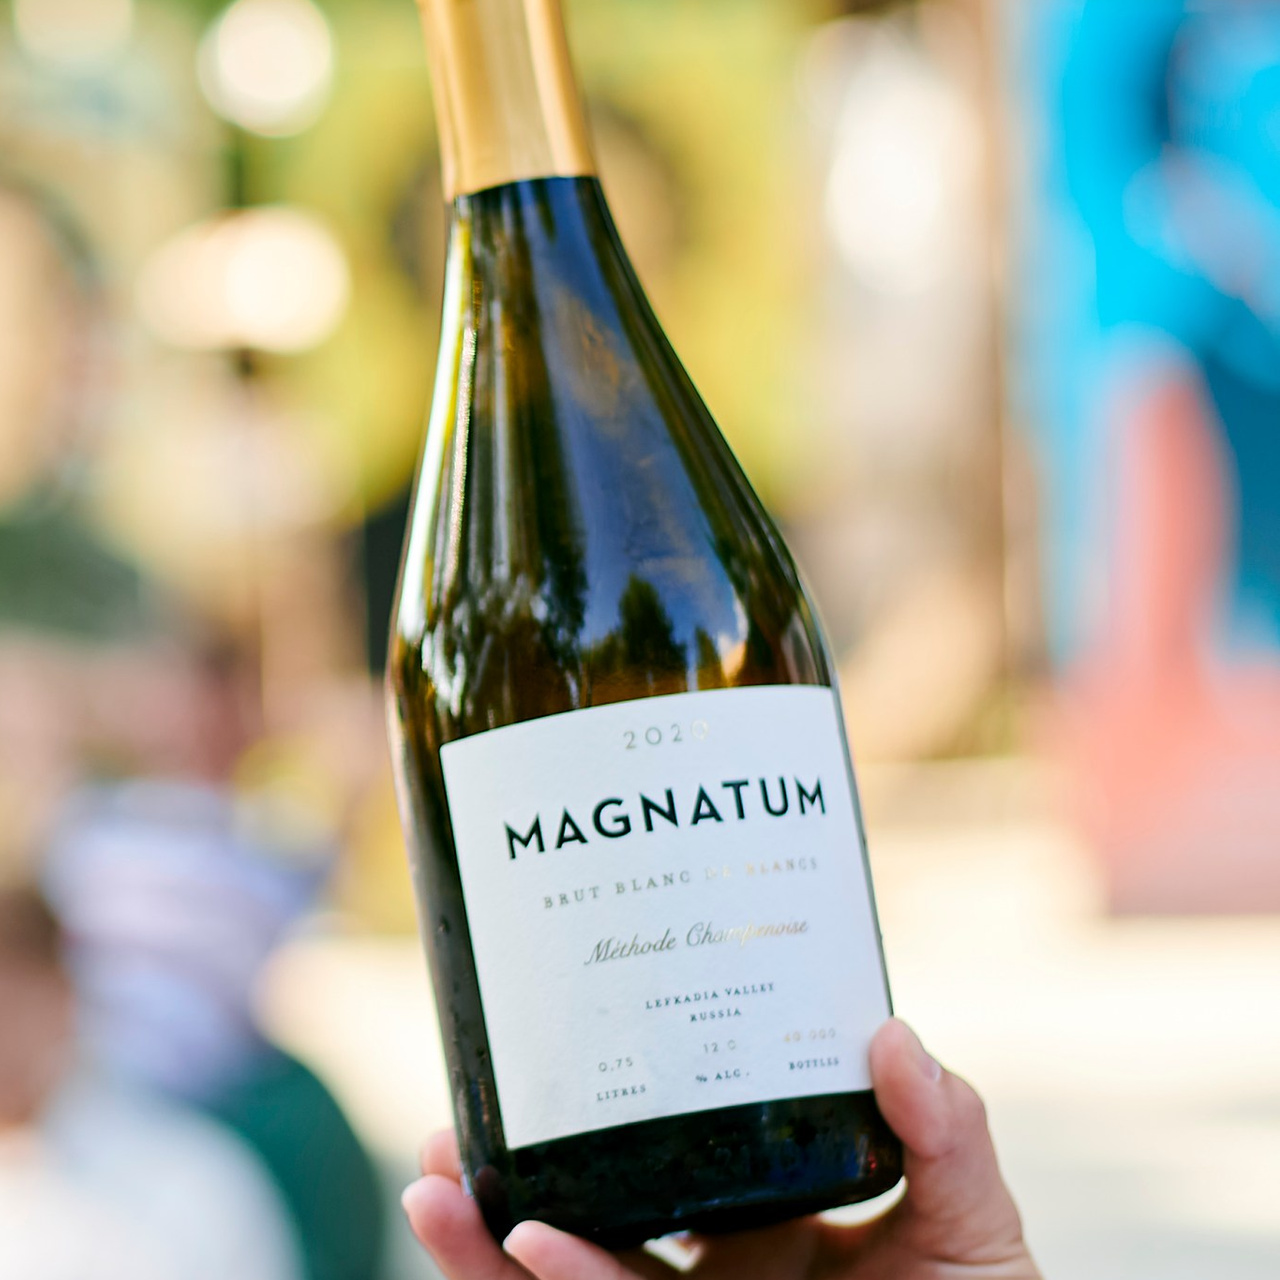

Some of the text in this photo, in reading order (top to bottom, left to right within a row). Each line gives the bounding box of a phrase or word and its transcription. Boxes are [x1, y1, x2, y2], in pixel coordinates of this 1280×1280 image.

[504, 776, 827, 861] MAGNATUM
[543, 886, 601, 910] BRUT
[615, 870, 692, 895] BLANC
[743, 856, 819, 877] BLANCS
[583, 919, 809, 966] Méthode Champenoise
[645, 981, 777, 1011] LEFKADIA VALLEY
[689, 1007, 743, 1023] RUSSIA
[788, 1056, 841, 1071] BOTTLES
[596, 1084, 648, 1102] LITRES
